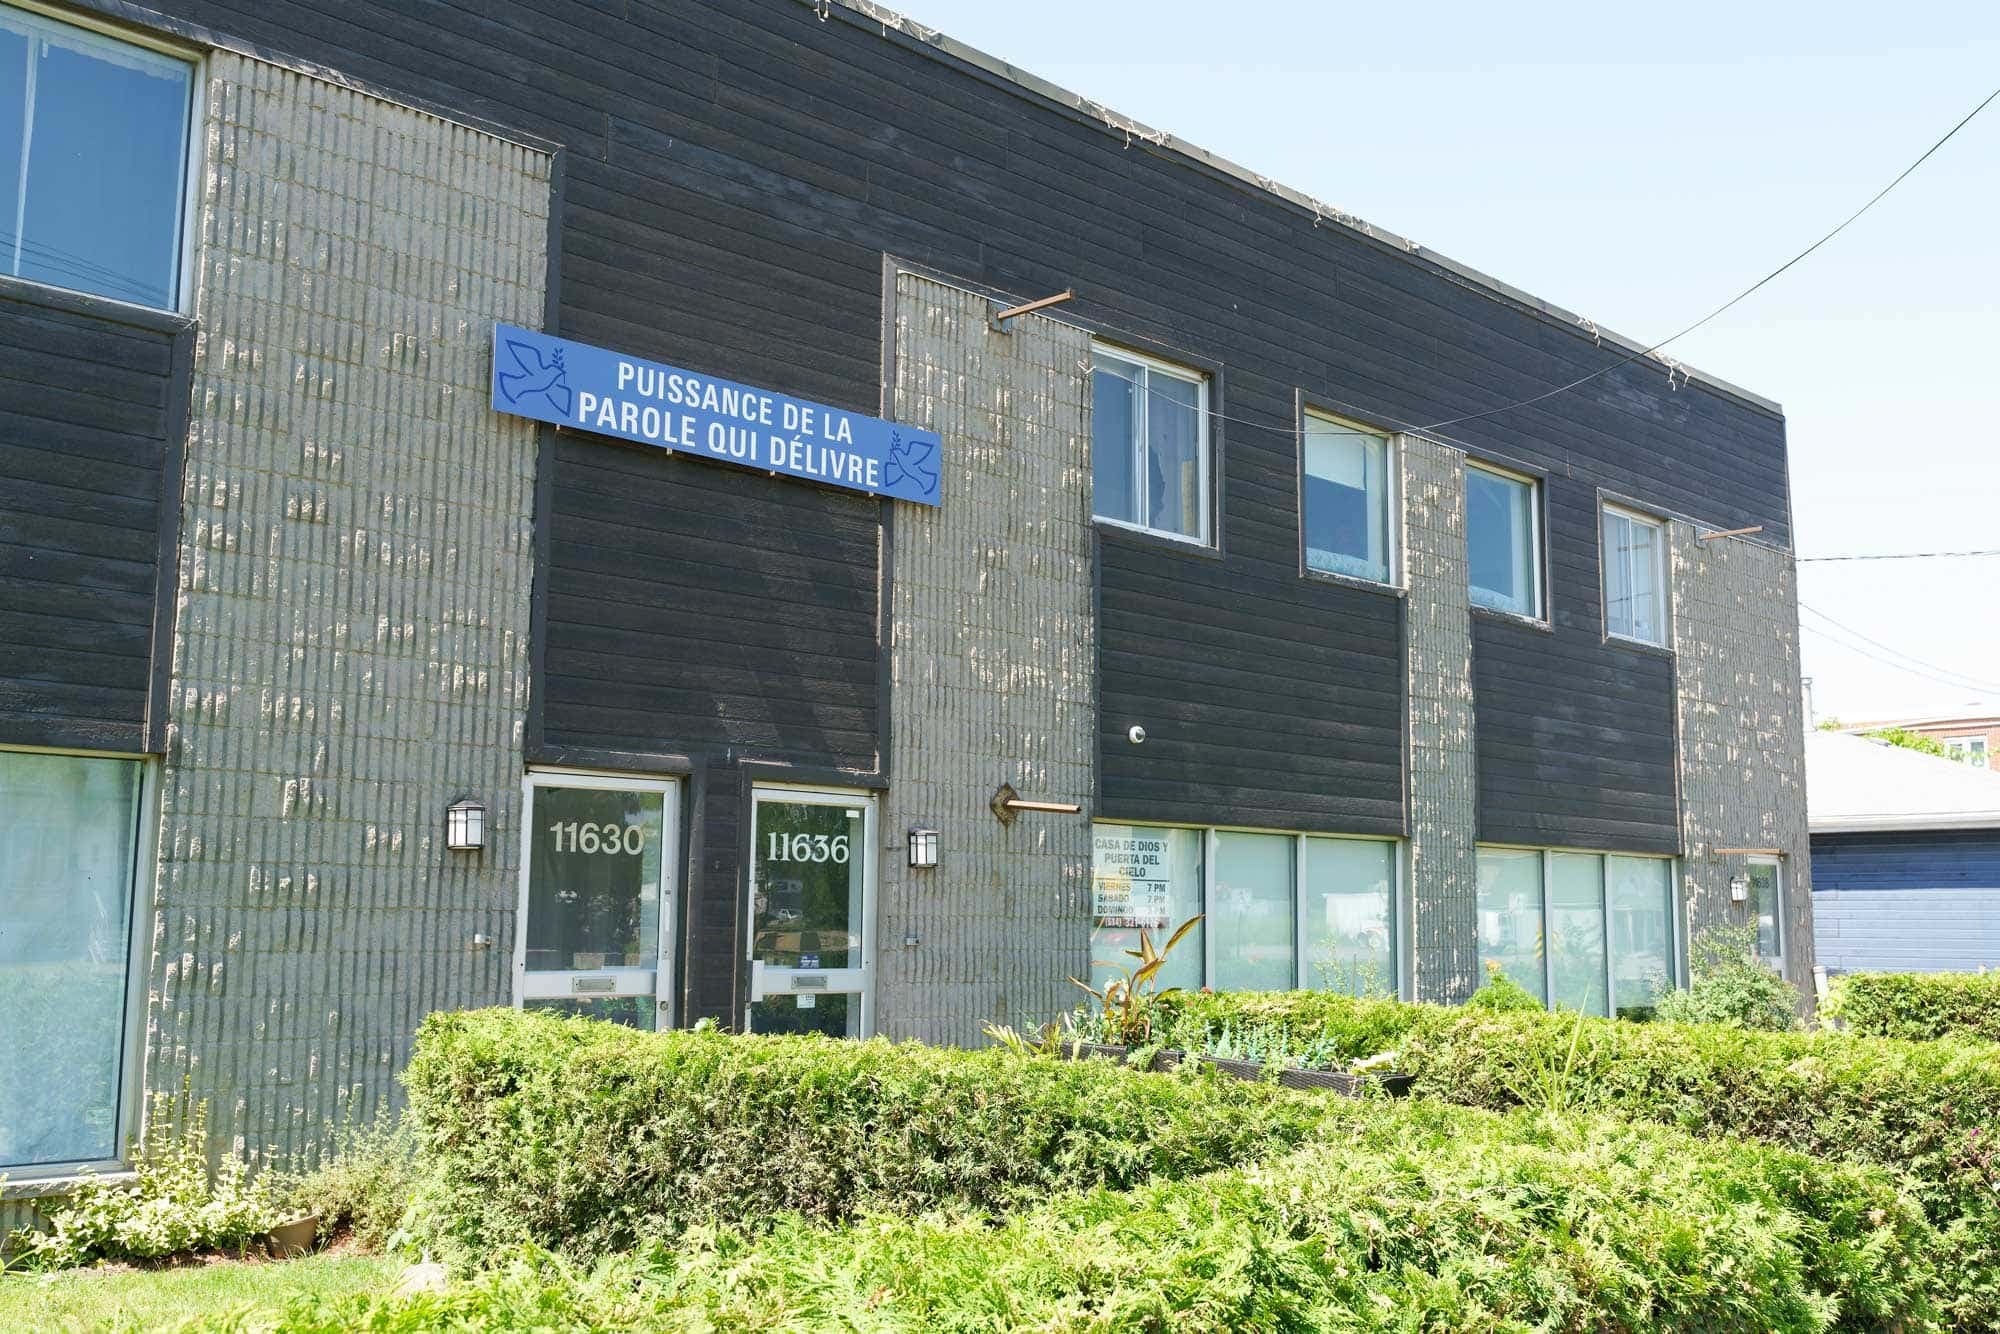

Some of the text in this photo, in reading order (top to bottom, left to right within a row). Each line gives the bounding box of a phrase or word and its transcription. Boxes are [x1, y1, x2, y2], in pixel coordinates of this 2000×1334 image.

[618, 361, 853, 445] PUISSANCE DE LA
[578, 391, 879, 488] PAROLE QUI DÉLIVRE
[550, 821, 645, 856] 11630
[767, 831, 850, 864] 11636
[1095, 839, 1168, 852] CASA DE DIOS Y
[1104, 853, 1160, 865] PUERTA DEL
[1119, 866, 1146, 878] CIELO
[1146, 883, 1152, 892] 7
[1154, 883, 1166, 892] PM
